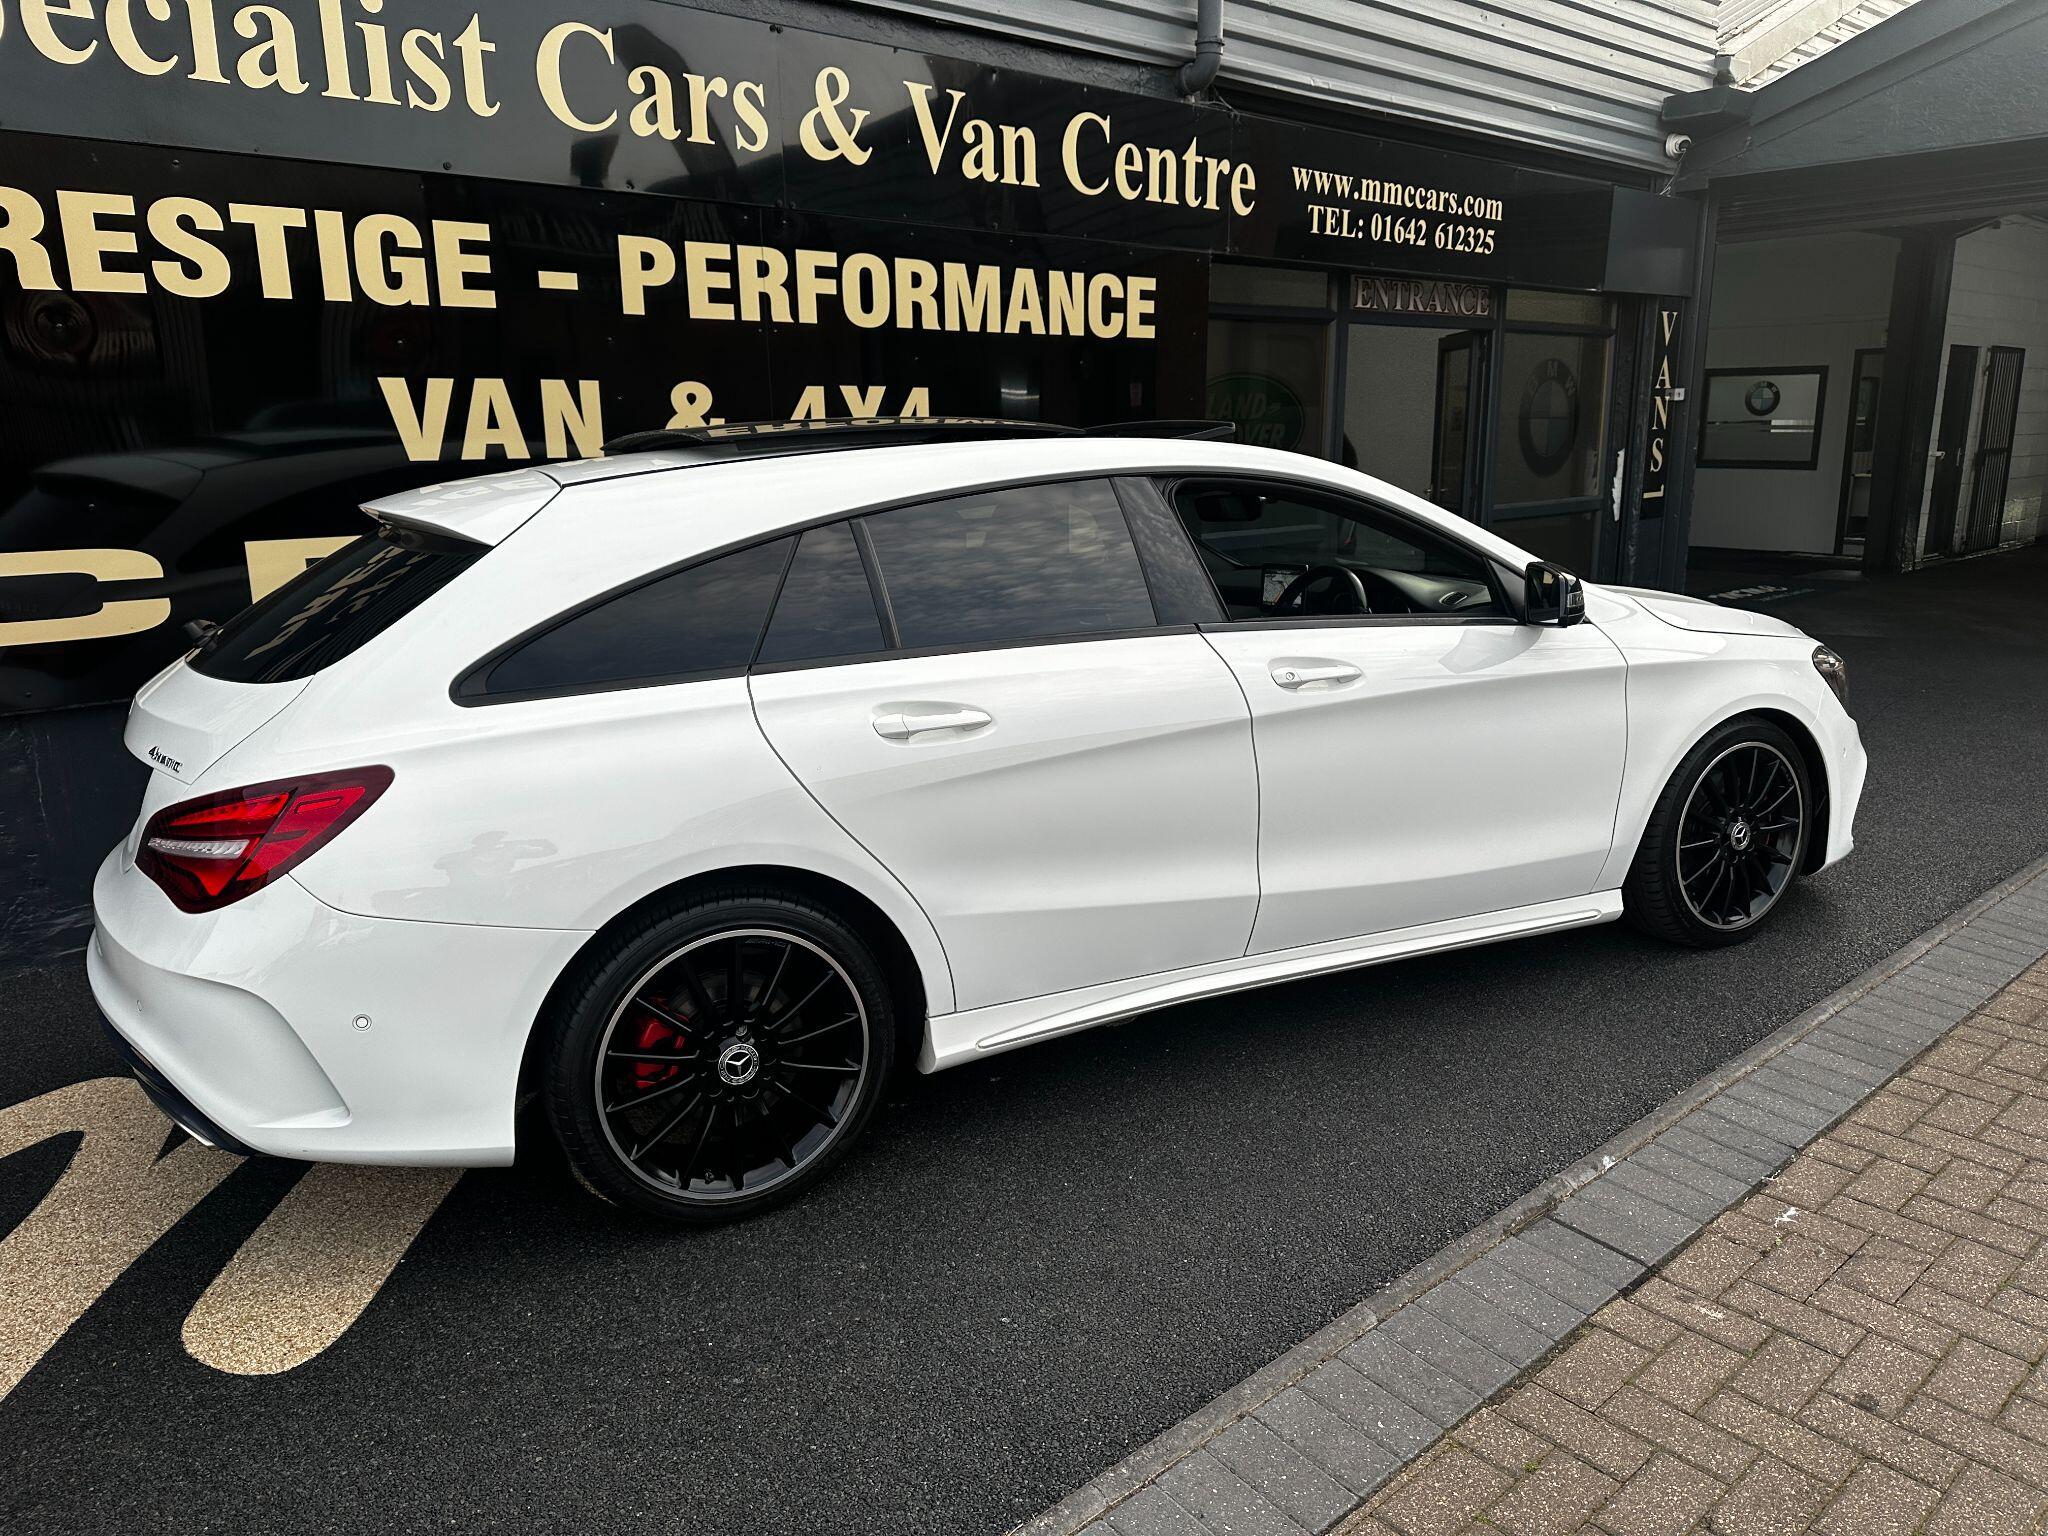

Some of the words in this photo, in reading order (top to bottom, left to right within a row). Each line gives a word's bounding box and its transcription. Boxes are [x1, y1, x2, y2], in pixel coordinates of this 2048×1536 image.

[0, 0, 501, 117] ecialist
[536, 21, 770, 153] Cars
[799, 66, 873, 167] &
[902, 80, 1041, 189] Van
[1061, 111, 1256, 216] Centre
[1291, 166, 1504, 221] www.mmccars.com
[1307, 204, 1364, 239] TEL:
[1370, 212, 1427, 246] 01642
[1434, 222, 1496, 254] 612325
[617, 234, 1157, 339] PERFORMANCE
[1353, 276, 1490, 316] ENTRANCE
[377, 376, 605, 462] VAN
[1650, 311, 1678, 472] VANS
